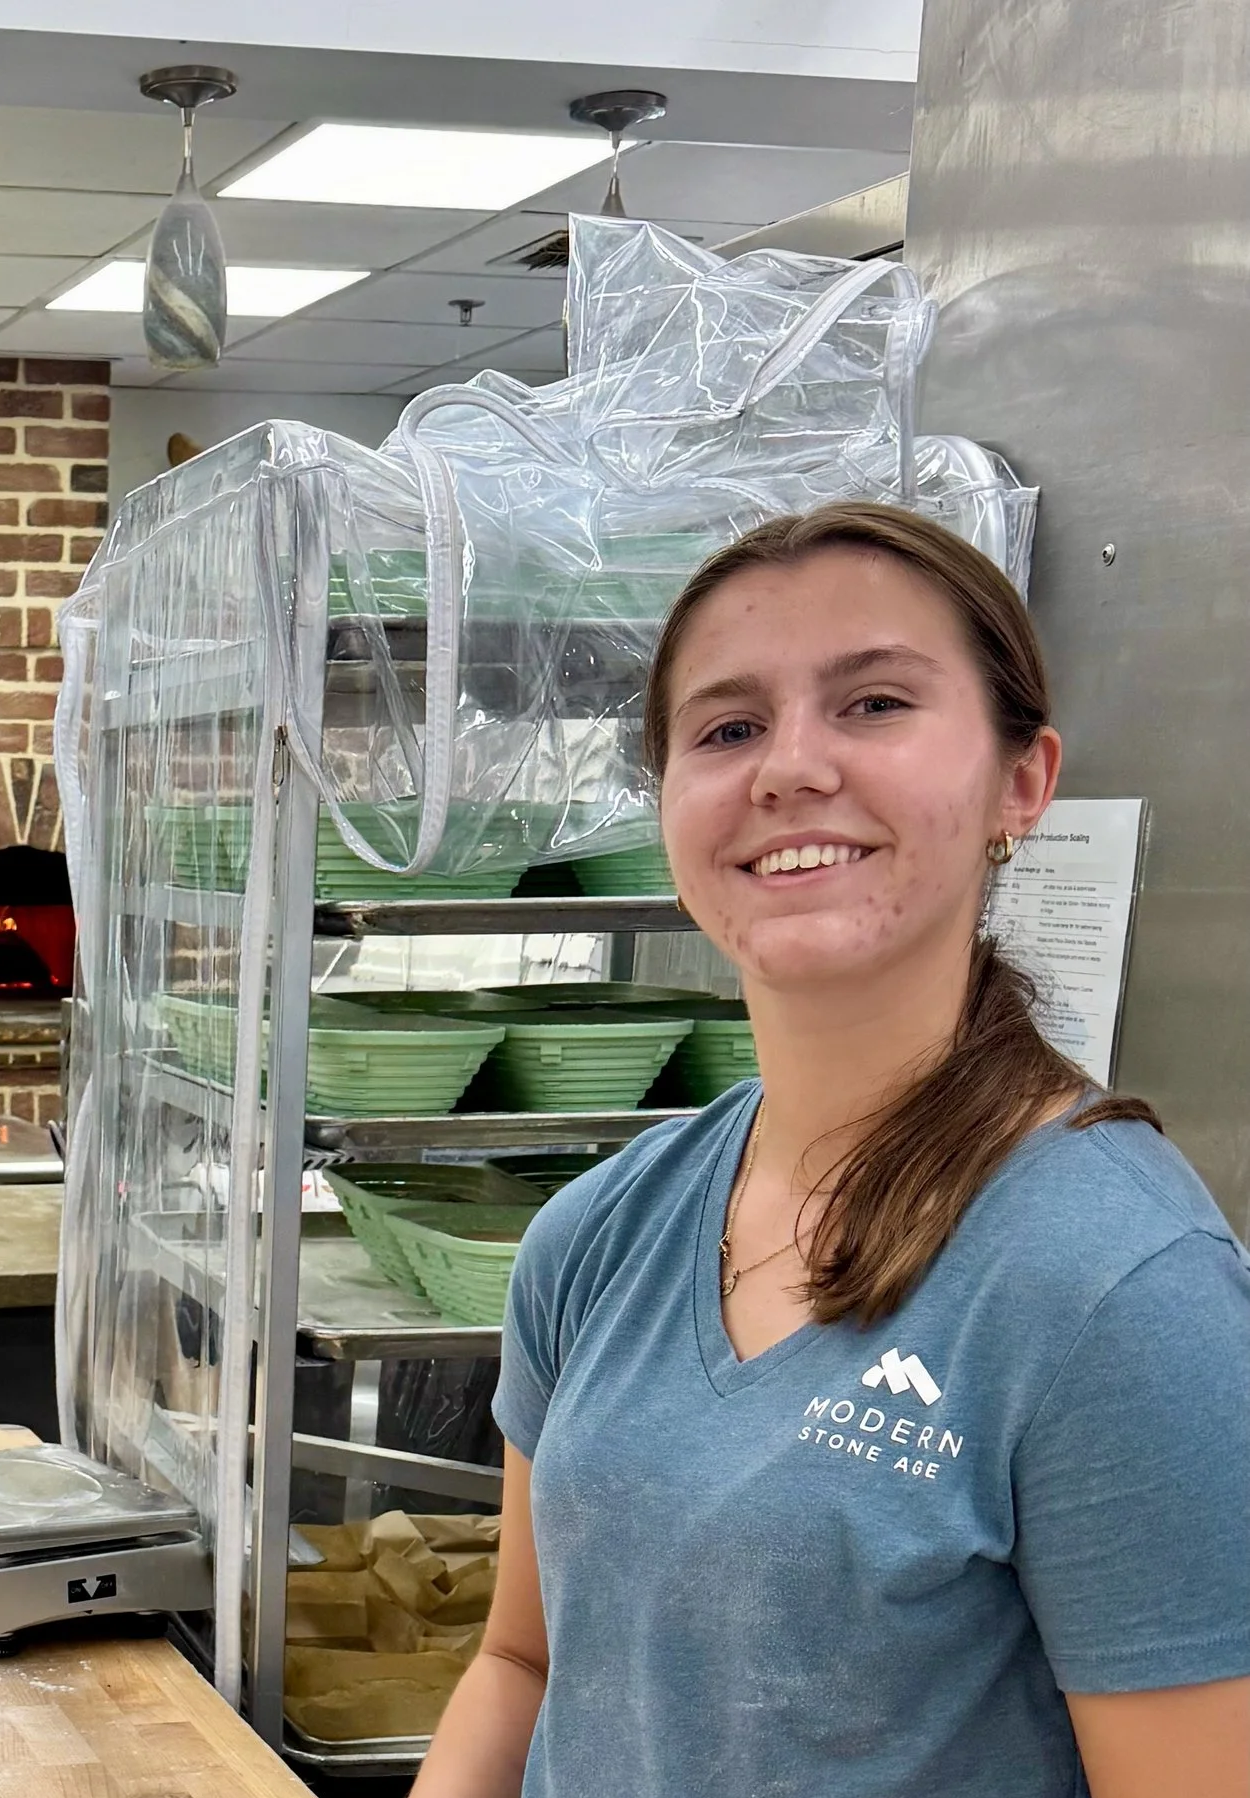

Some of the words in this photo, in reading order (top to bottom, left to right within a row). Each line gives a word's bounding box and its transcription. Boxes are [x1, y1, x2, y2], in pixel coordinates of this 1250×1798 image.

[797, 1426, 883, 1462] STONE
[893, 1456, 940, 1479] AGE
[803, 1396, 964, 1458] MODERN
